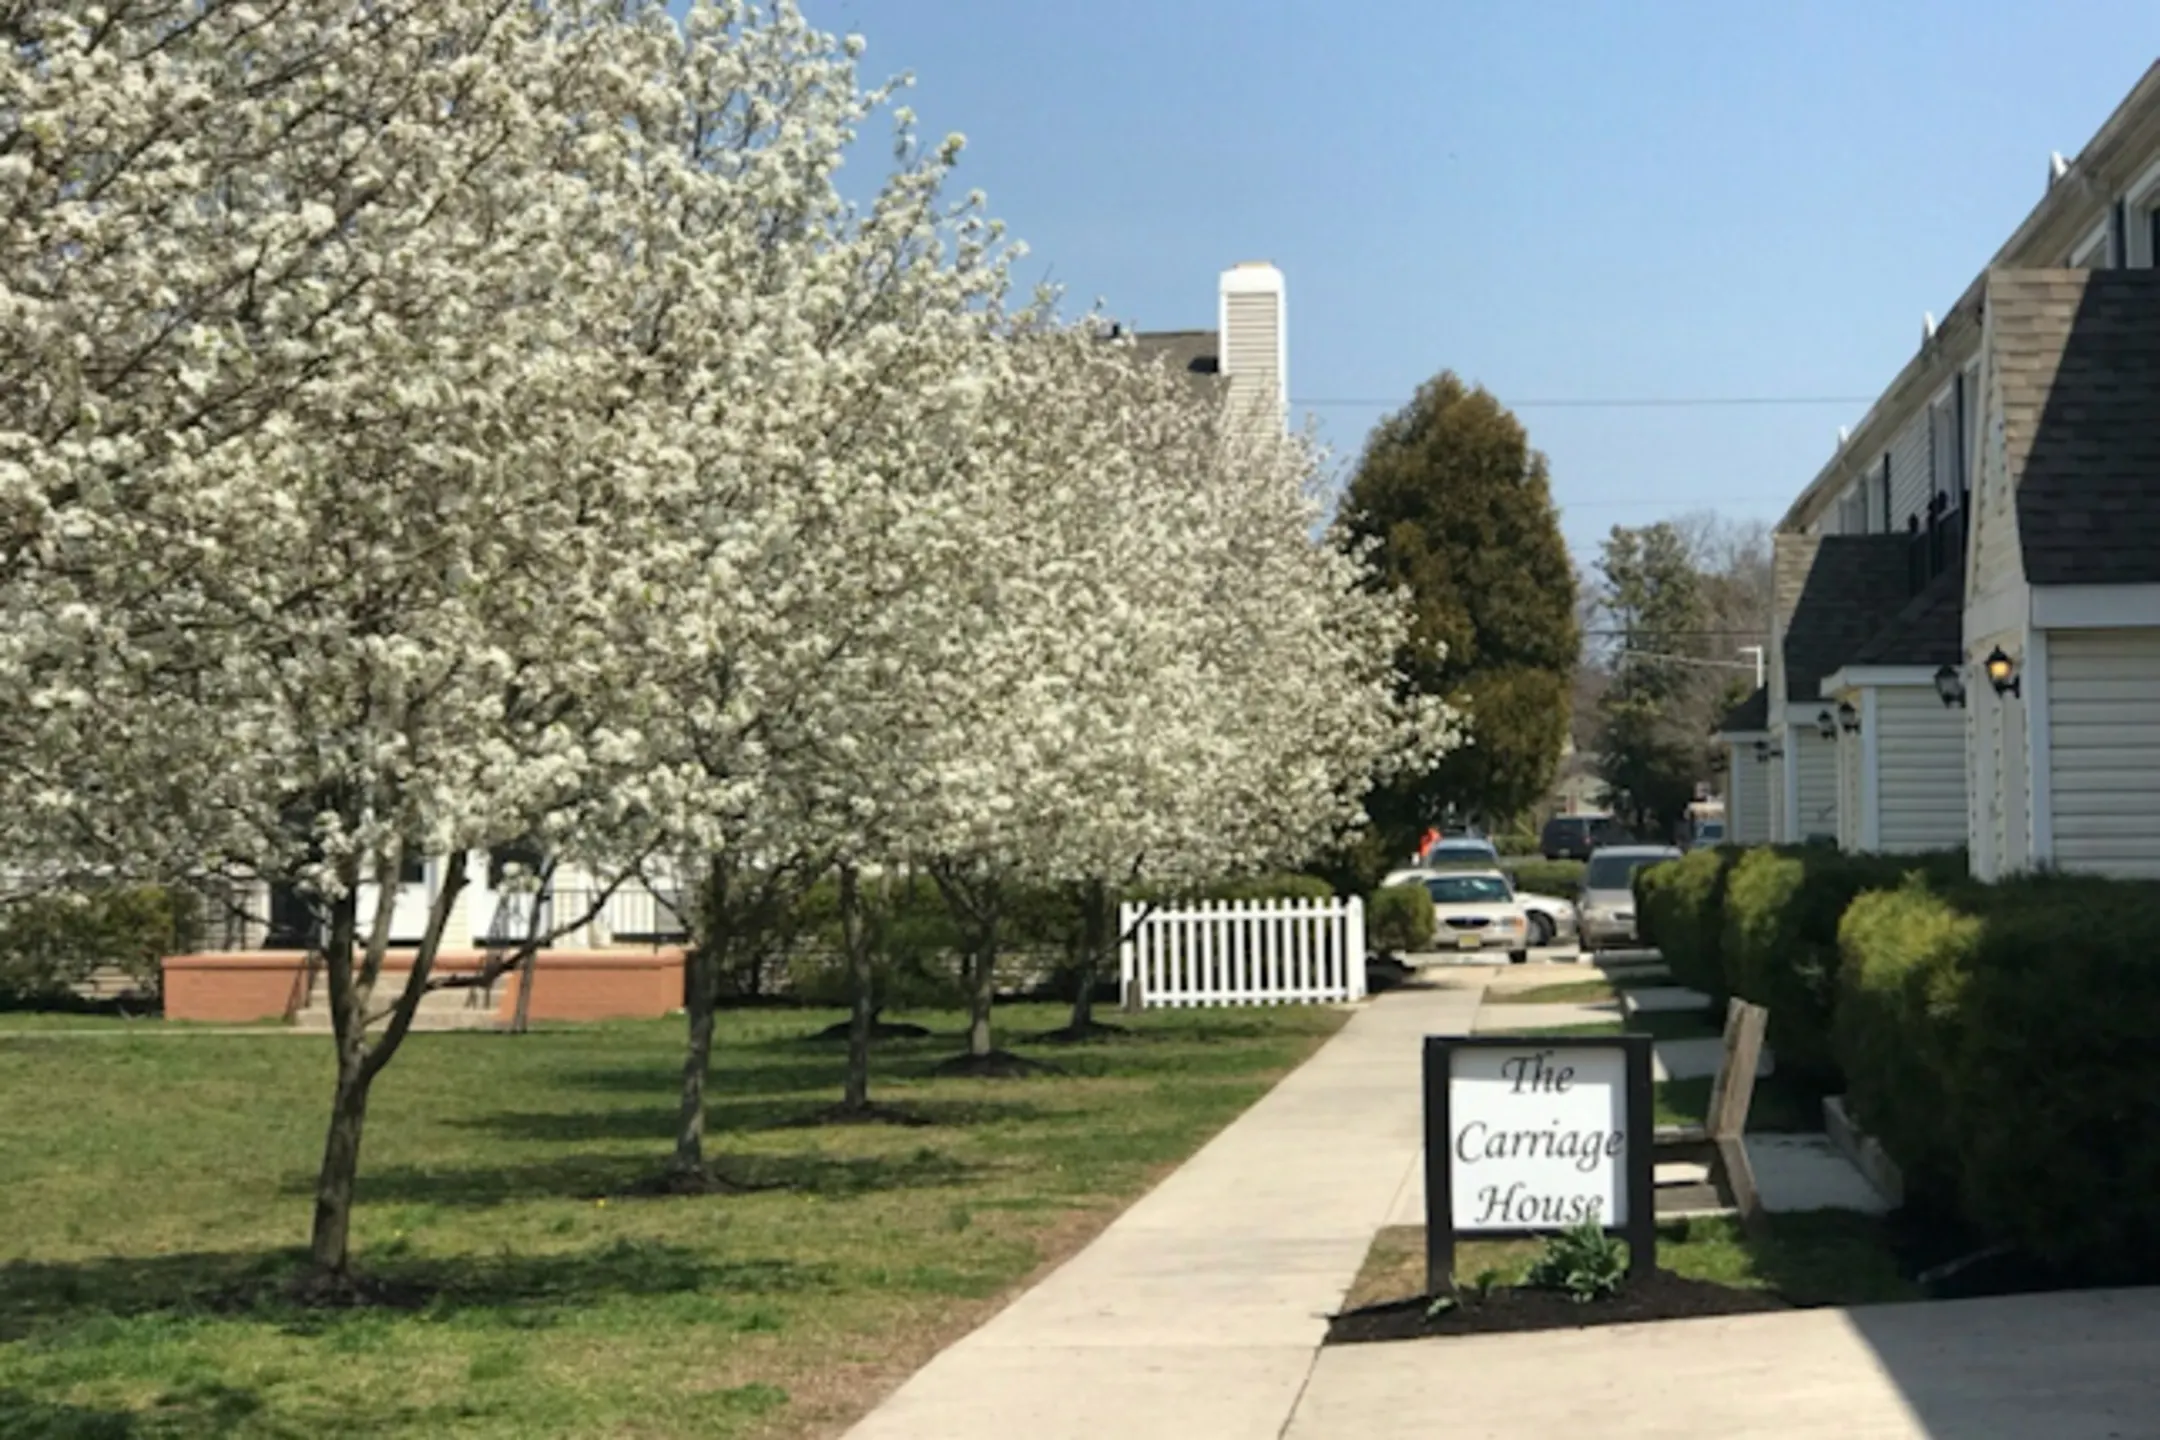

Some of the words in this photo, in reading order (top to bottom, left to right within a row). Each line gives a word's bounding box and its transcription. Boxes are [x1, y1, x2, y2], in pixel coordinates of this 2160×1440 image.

[1501, 1050, 1575, 1094] The
[1455, 1118, 1625, 1173] Carriage
[1474, 1181, 1604, 1224] House
